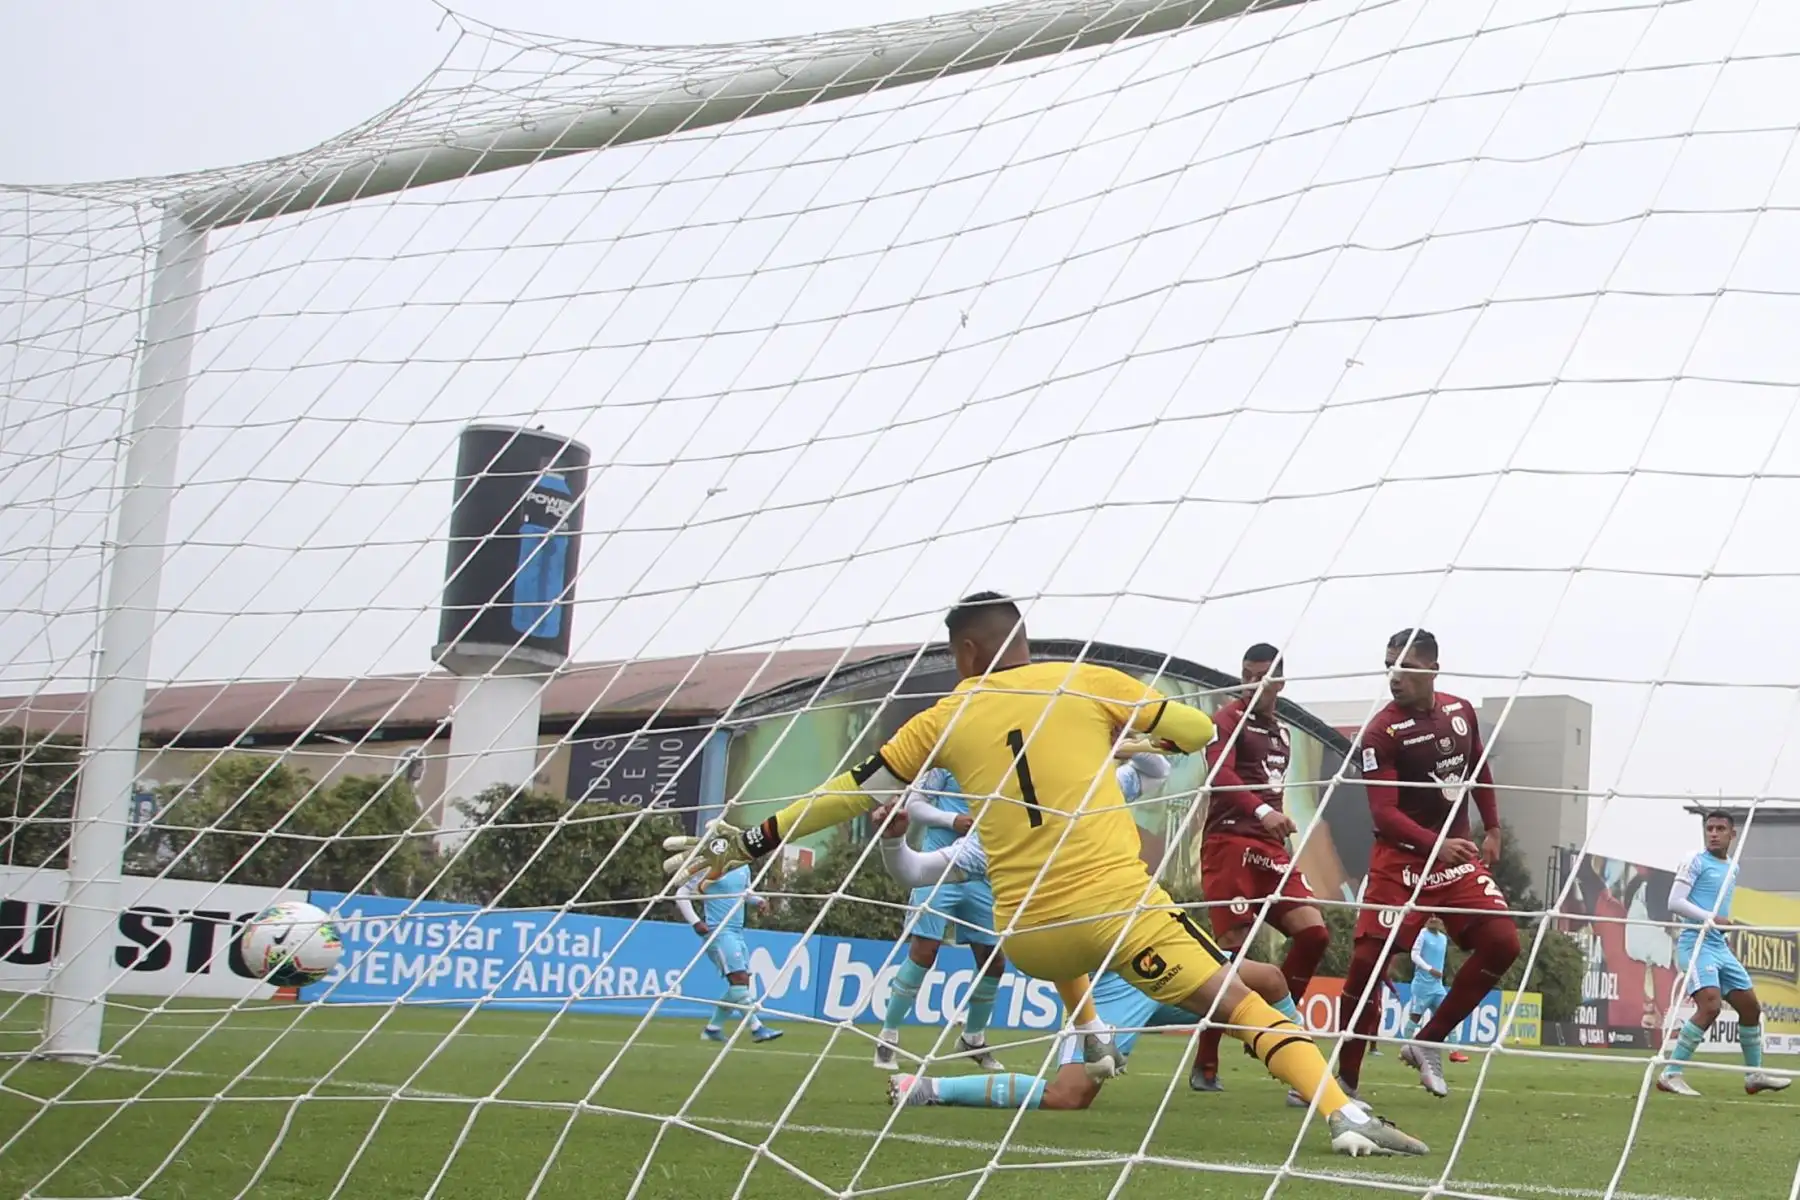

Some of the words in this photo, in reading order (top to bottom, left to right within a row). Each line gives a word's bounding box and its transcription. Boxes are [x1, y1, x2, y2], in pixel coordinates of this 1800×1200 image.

[1007, 729, 1042, 828] 1
[329, 906, 502, 951] Movistar
[1736, 930, 1795, 973] CRISTAL
[513, 960, 683, 996] AHORRAS
[823, 943, 1057, 1028] betcis
[1600, 972, 1620, 1000] DEL
